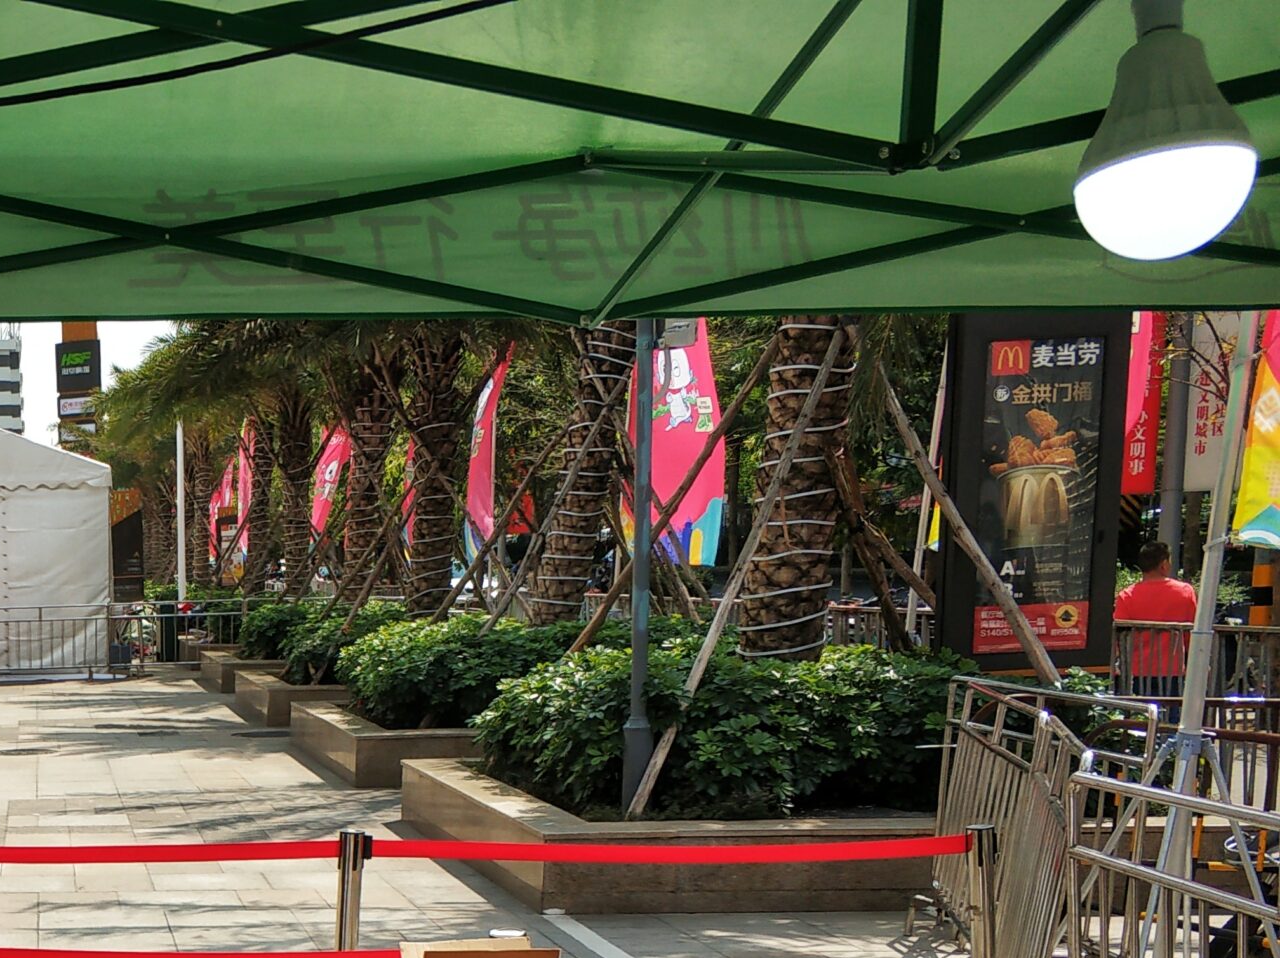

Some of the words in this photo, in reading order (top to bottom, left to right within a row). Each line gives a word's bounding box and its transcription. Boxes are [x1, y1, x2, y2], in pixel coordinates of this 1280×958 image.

[1032, 342, 1100, 368] 麦当劳
[1012, 381, 1094, 404] 金拱门桶
